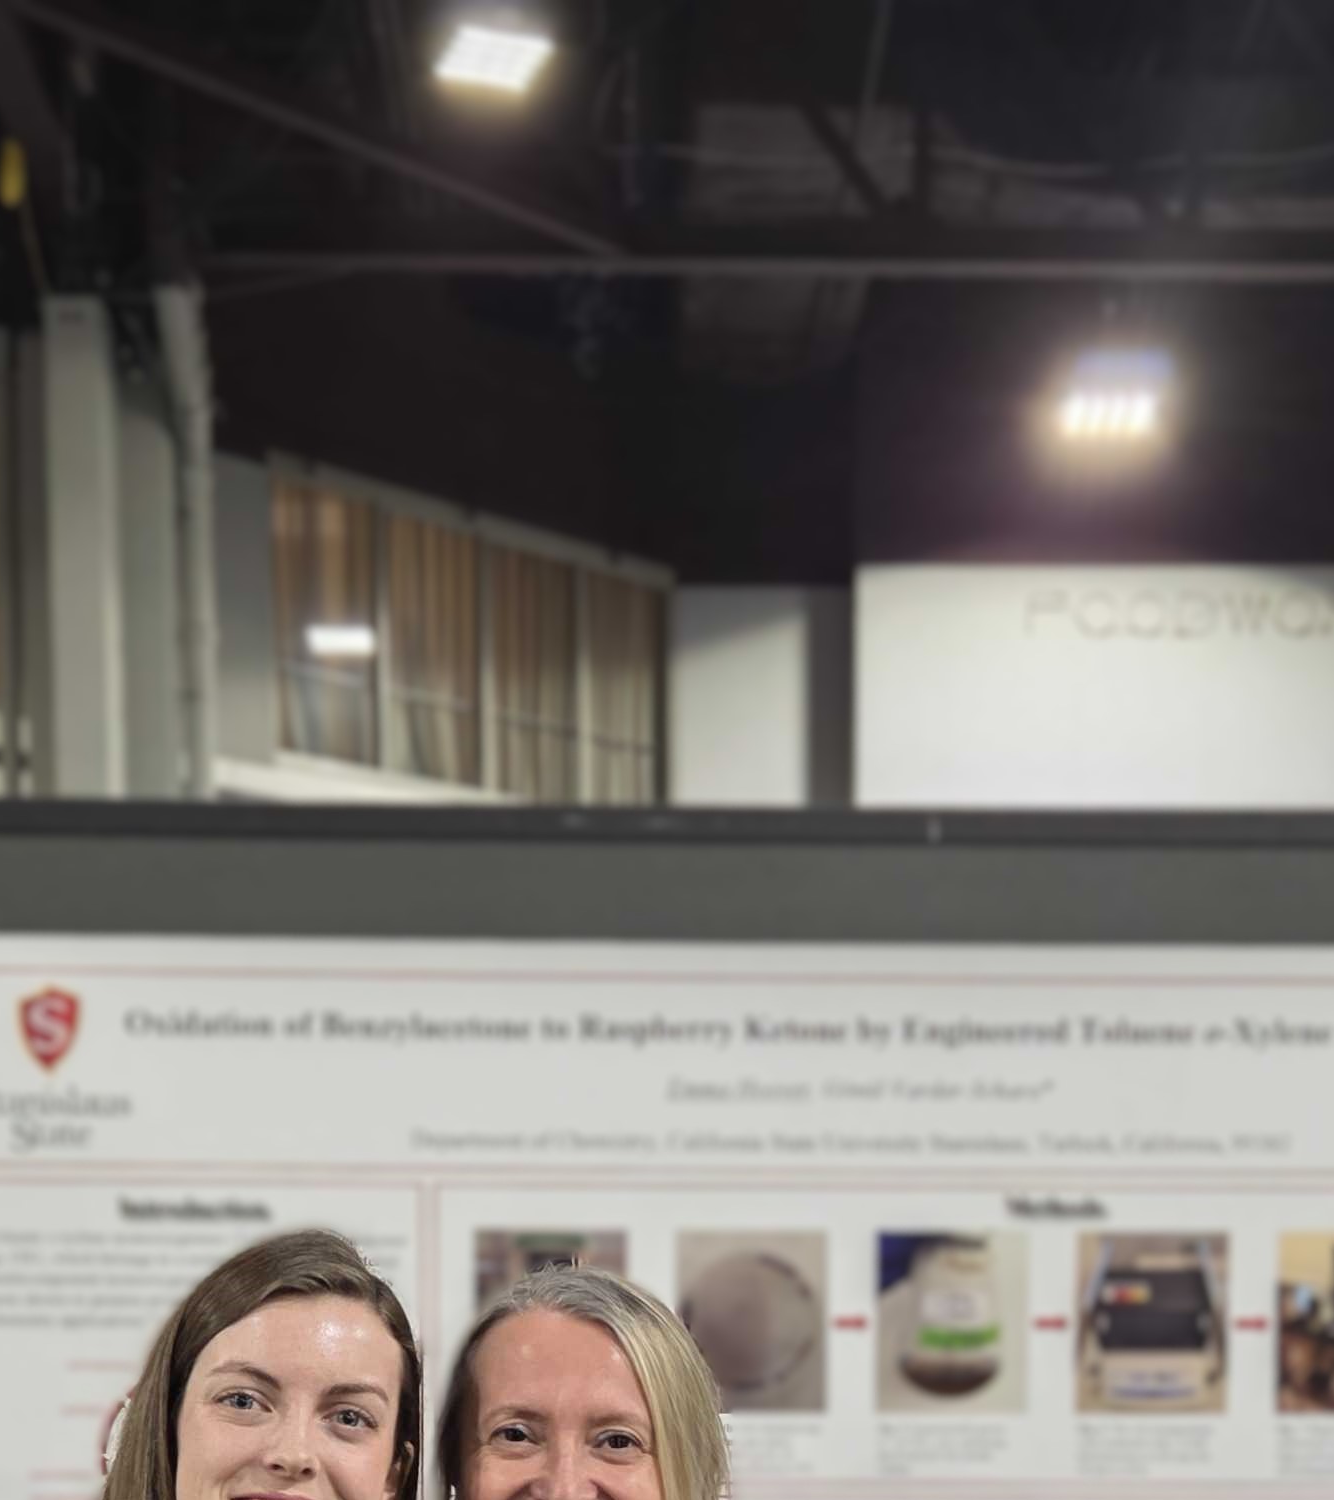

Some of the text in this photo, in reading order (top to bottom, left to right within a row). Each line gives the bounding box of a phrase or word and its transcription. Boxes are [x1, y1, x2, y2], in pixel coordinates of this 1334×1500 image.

[124, 1009, 269, 1038] Oxidation
[284, 1010, 313, 1038] of
[540, 1014, 570, 1040] to
[578, 1012, 733, 1047] Raspberry
[744, 1013, 847, 1043] Ketone
[860, 1014, 894, 1048] by
[902, 1015, 1069, 1050] Engineered
[1081, 1016, 1195, 1045] Toluene
